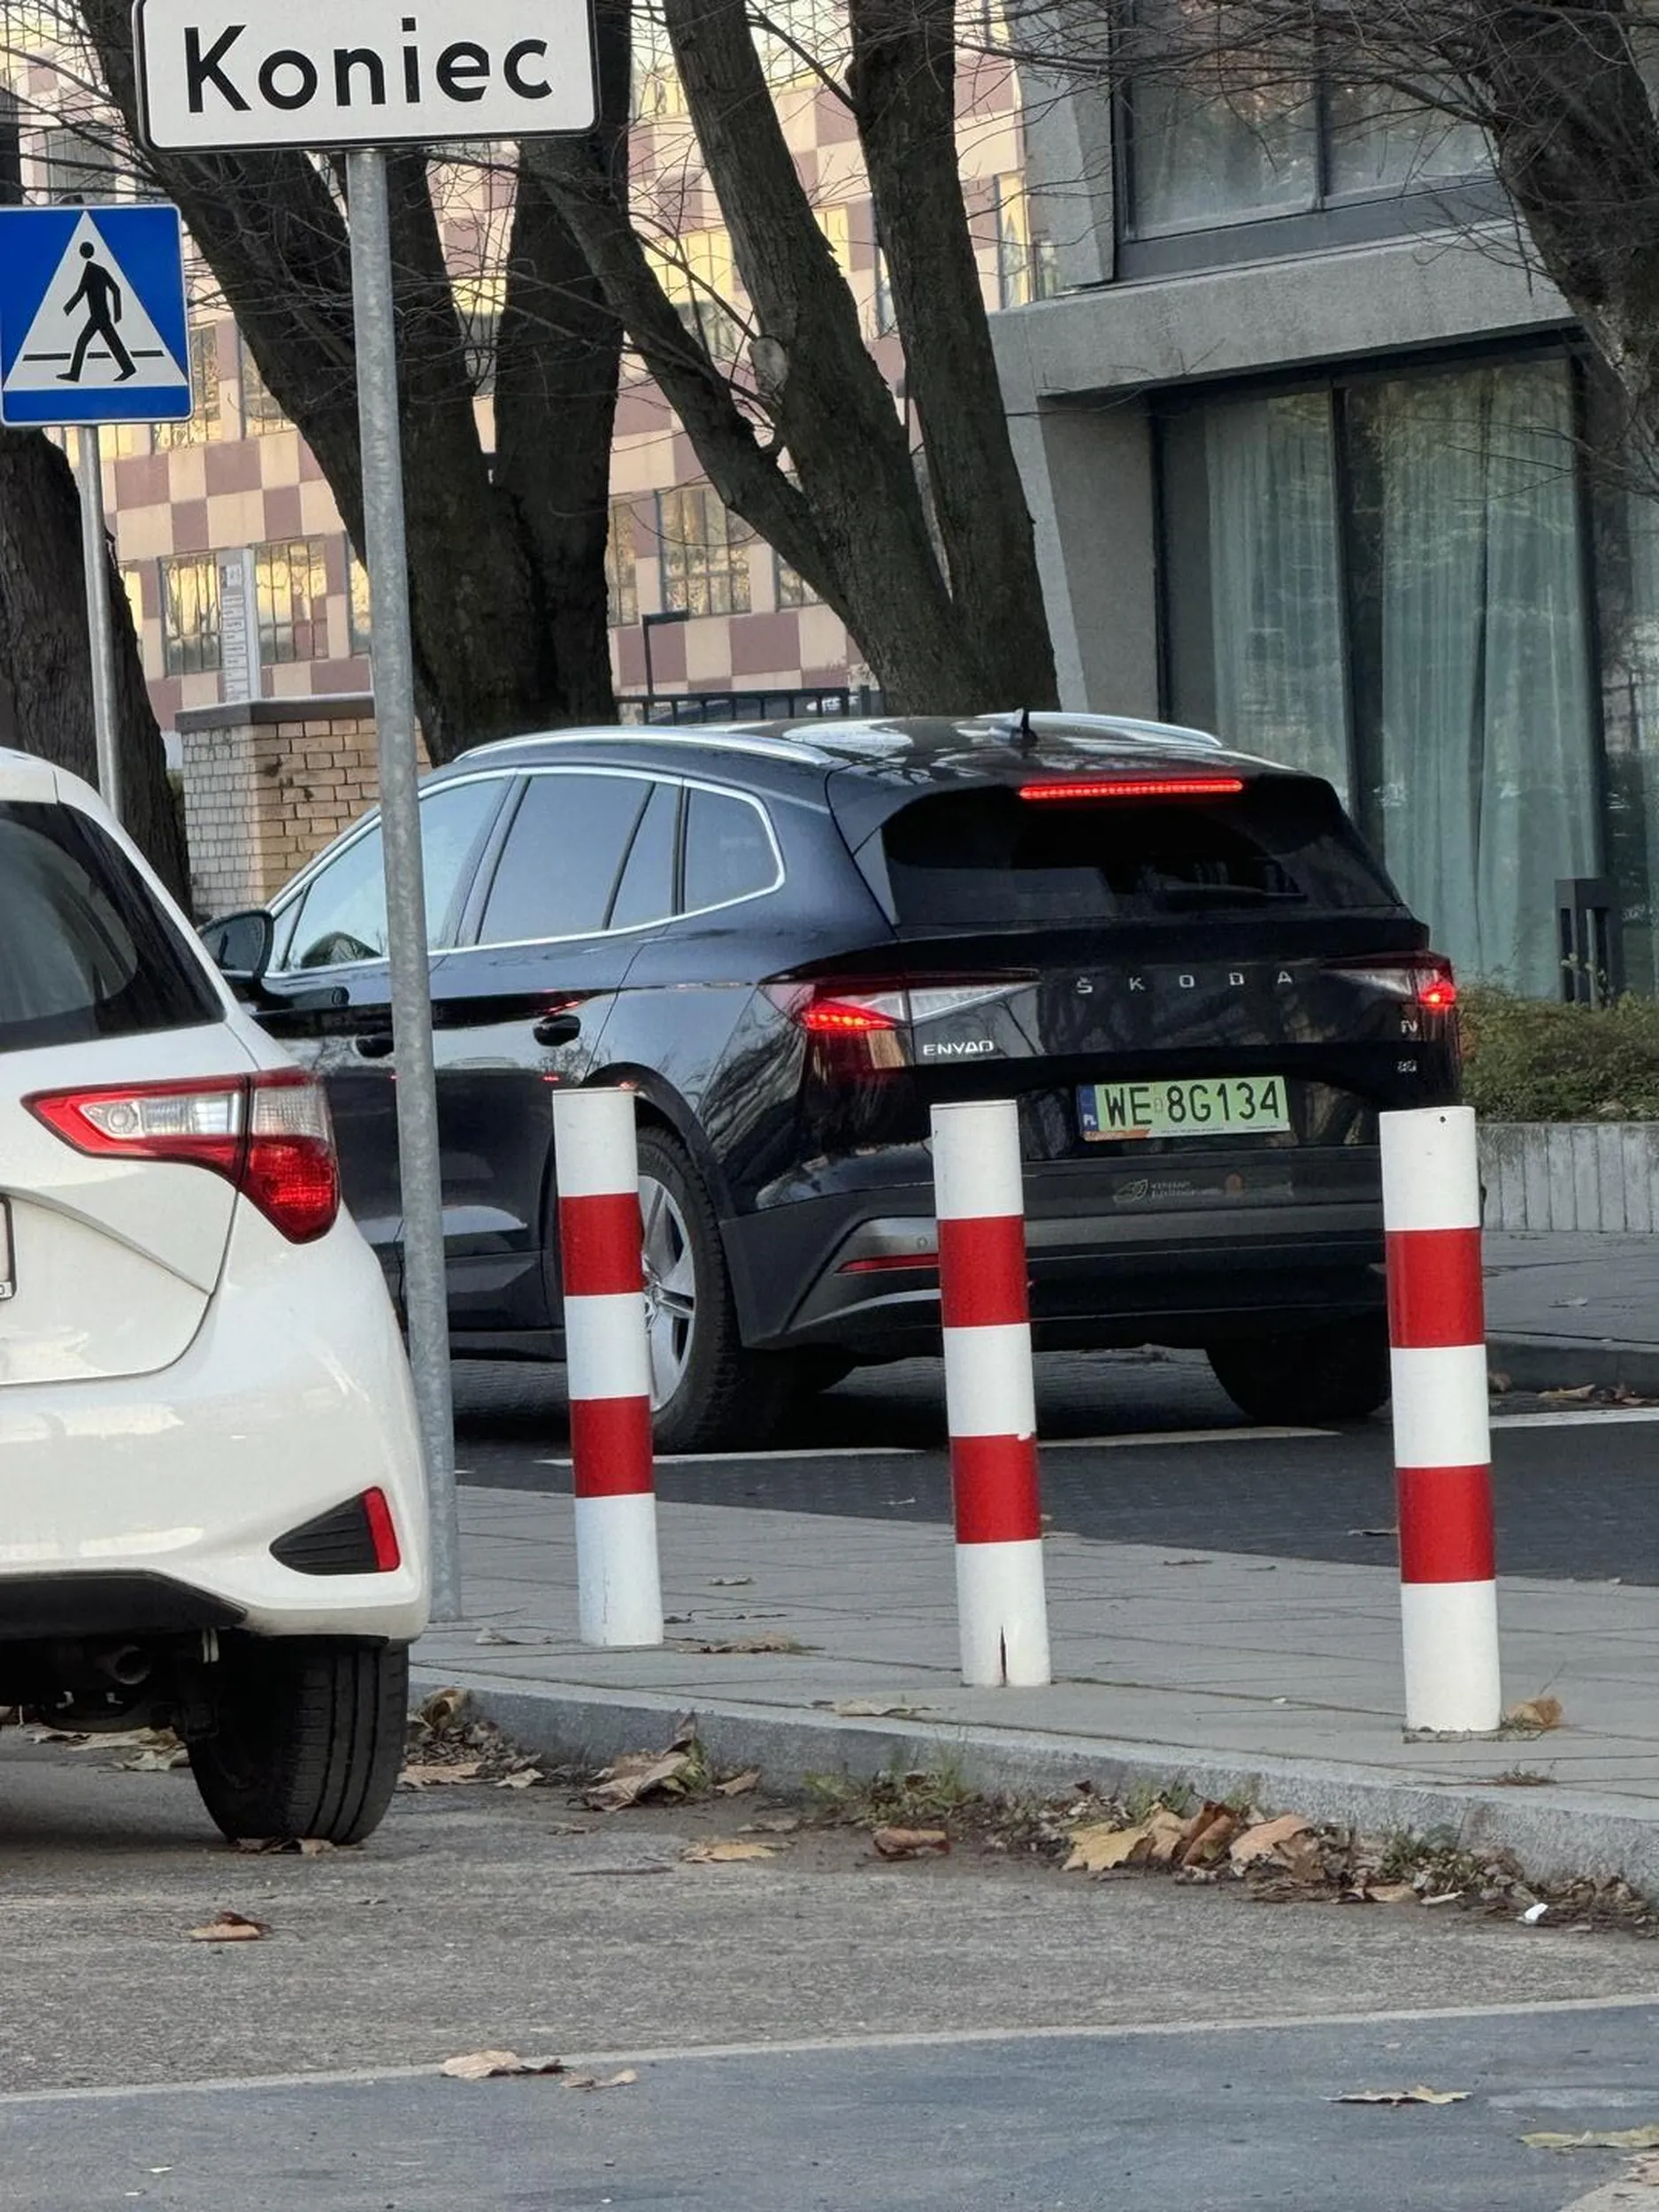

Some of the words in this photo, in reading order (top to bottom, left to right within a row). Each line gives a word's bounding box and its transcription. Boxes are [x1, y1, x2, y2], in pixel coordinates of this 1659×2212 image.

[184, 17, 554, 113] Koniec
[1076, 971, 1293, 994] ŠKODA
[1083, 1115, 1097, 1126] PL
[1104, 1087, 1153, 1128] WE
[1166, 1080, 1279, 1124] 8G134
